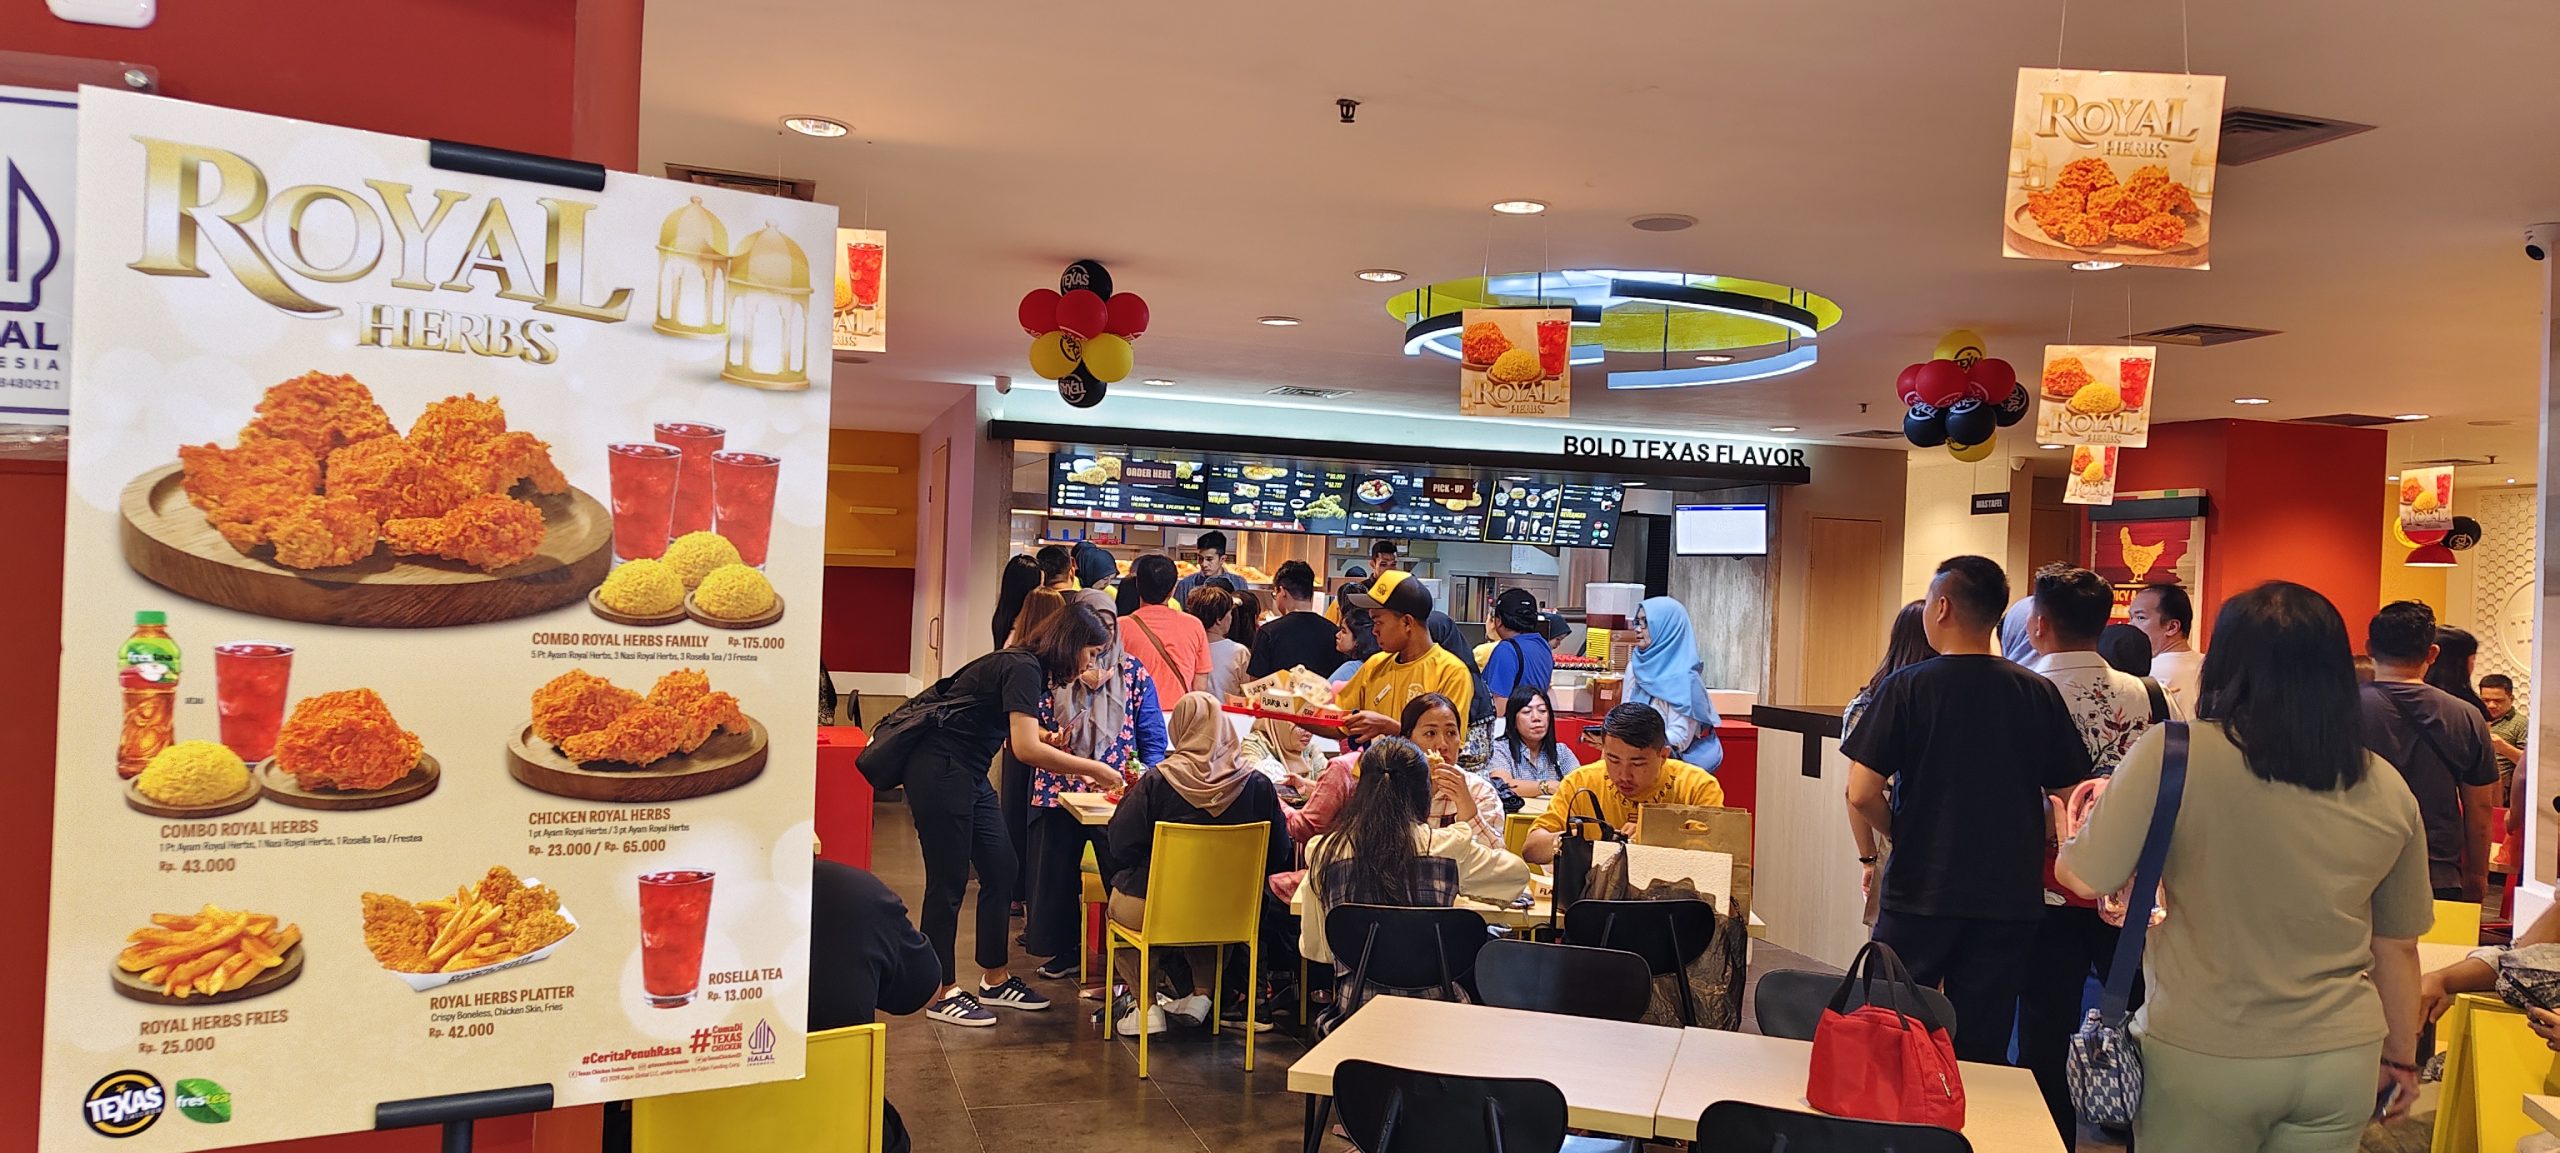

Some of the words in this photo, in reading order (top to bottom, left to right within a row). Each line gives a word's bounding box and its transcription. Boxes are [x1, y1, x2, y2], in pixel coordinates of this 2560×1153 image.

[2035, 92, 2200, 149] ROYAL
[2103, 139, 2170, 158] HERBS
[128, 135, 635, 324] ROYAL
[1062, 271, 1090, 289] TEXAS
[355, 301, 559, 365] HERBS
[1472, 380, 1562, 408] ROYAL
[1509, 405, 1545, 414] HERBS
[2049, 411, 2139, 437] ROYAL
[1564, 435, 1627, 458] BOLD
[1632, 439, 1710, 463] TEXAS
[1716, 444, 1807, 468] FLAVOR
[1126, 467, 1151, 478] ORDER
[1152, 468, 1172, 479] HERE
[1433, 483, 1450, 493] PICK
[1454, 484, 1465, 494] UP
[532, 632, 581, 646] COMBO
[582, 633, 621, 647] ROYAL
[623, 634, 663, 647] HERBS
[665, 635, 709, 648] FAMILY
[743, 637, 785, 649] 175.000
[547, 651, 567, 660] Ayam
[569, 651, 588, 661] Royal
[620, 652, 635, 660] Nasi
[637, 652, 655, 661] Royal
[686, 653, 710, 661] Rosella
[711, 653, 722, 661] Tea
[528, 810, 587, 825] CHICKEN
[589, 809, 628, 823] ROYAL
[631, 808, 671, 821] HERBS
[160, 823, 218, 838] COMBO
[221, 821, 268, 837] ROYAL
[270, 820, 319, 834] HERBS
[543, 828, 564, 839] Ayam
[564, 827, 584, 838] Royal
[585, 826, 607, 835] Herbs
[628, 825, 647, 835] Ayam
[648, 824, 667, 834] Royal
[668, 823, 690, 832] Herbs
[203, 841, 226, 853] Royal
[283, 838, 305, 849] Royal
[373, 834, 386, 844] Tea
[393, 834, 423, 844] Frestea
[548, 842, 591, 857] 23.000
[623, 839, 667, 854] 65.000
[181, 858, 236, 873] 43.000
[708, 971, 759, 985] ROSELLA
[763, 967, 783, 981] TEA
[430, 993, 471, 1010] ROYAL
[474, 990, 518, 1006] HERBS
[520, 985, 575, 1002] PLATTER
[725, 987, 763, 1001] 13.000
[431, 1011, 456, 1023] Crispy
[457, 1009, 493, 1020] Boneless,
[494, 1006, 524, 1017] Chicken
[525, 1004, 543, 1014] Skin,
[545, 1002, 563, 1012] Fries
[140, 1018, 189, 1036] ROYAL
[192, 1013, 242, 1031] HERBS
[245, 1009, 289, 1026] FRIES
[448, 1022, 495, 1039] 42.000
[161, 1036, 215, 1055] 25.000
[712, 1032, 742, 1044] TEXAS
[582, 1045, 682, 1065] #CeritaPenuhRasa
[86, 1085, 163, 1124] TEXAS
